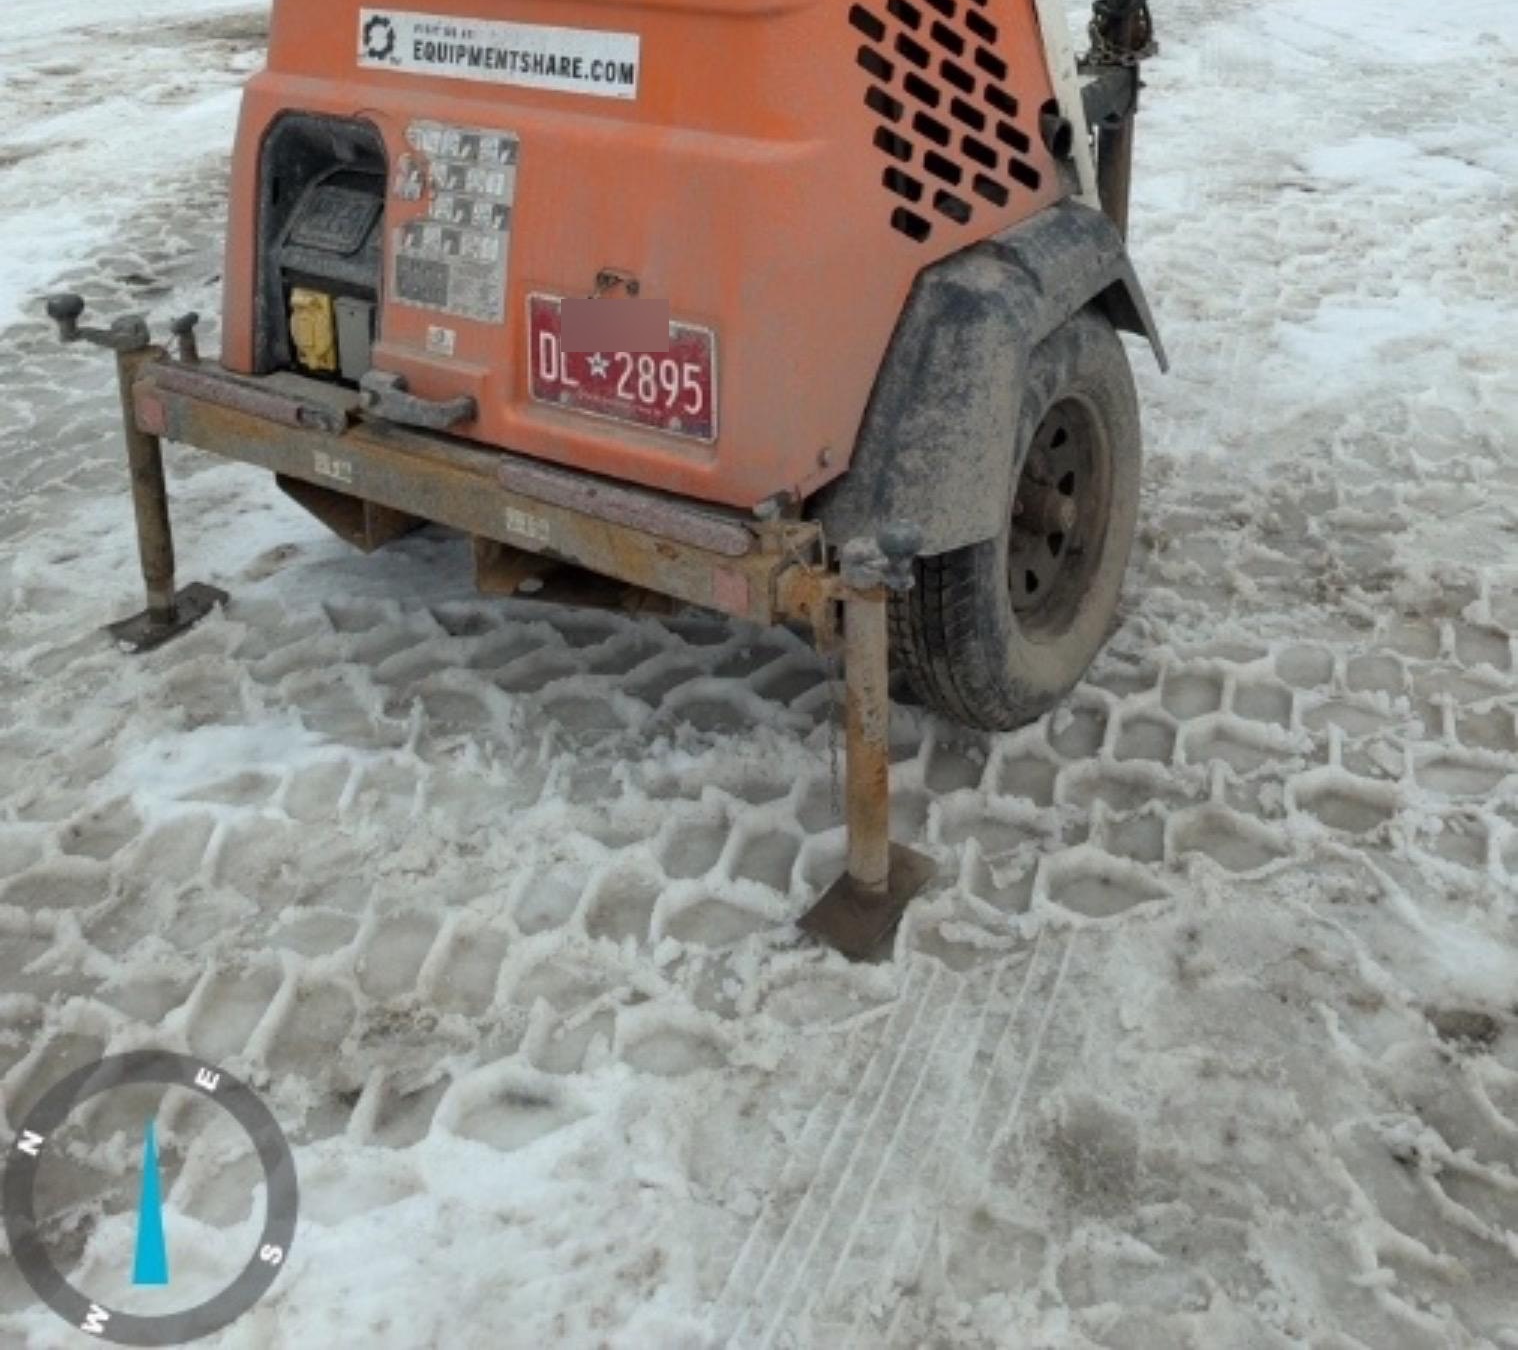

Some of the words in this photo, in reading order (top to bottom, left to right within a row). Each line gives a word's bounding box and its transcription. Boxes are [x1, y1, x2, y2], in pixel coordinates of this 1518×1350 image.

[412, 38, 636, 85] EQUIPMENTSHARE.COM
[538, 330, 580, 387] DL
[613, 351, 705, 416] 2895
